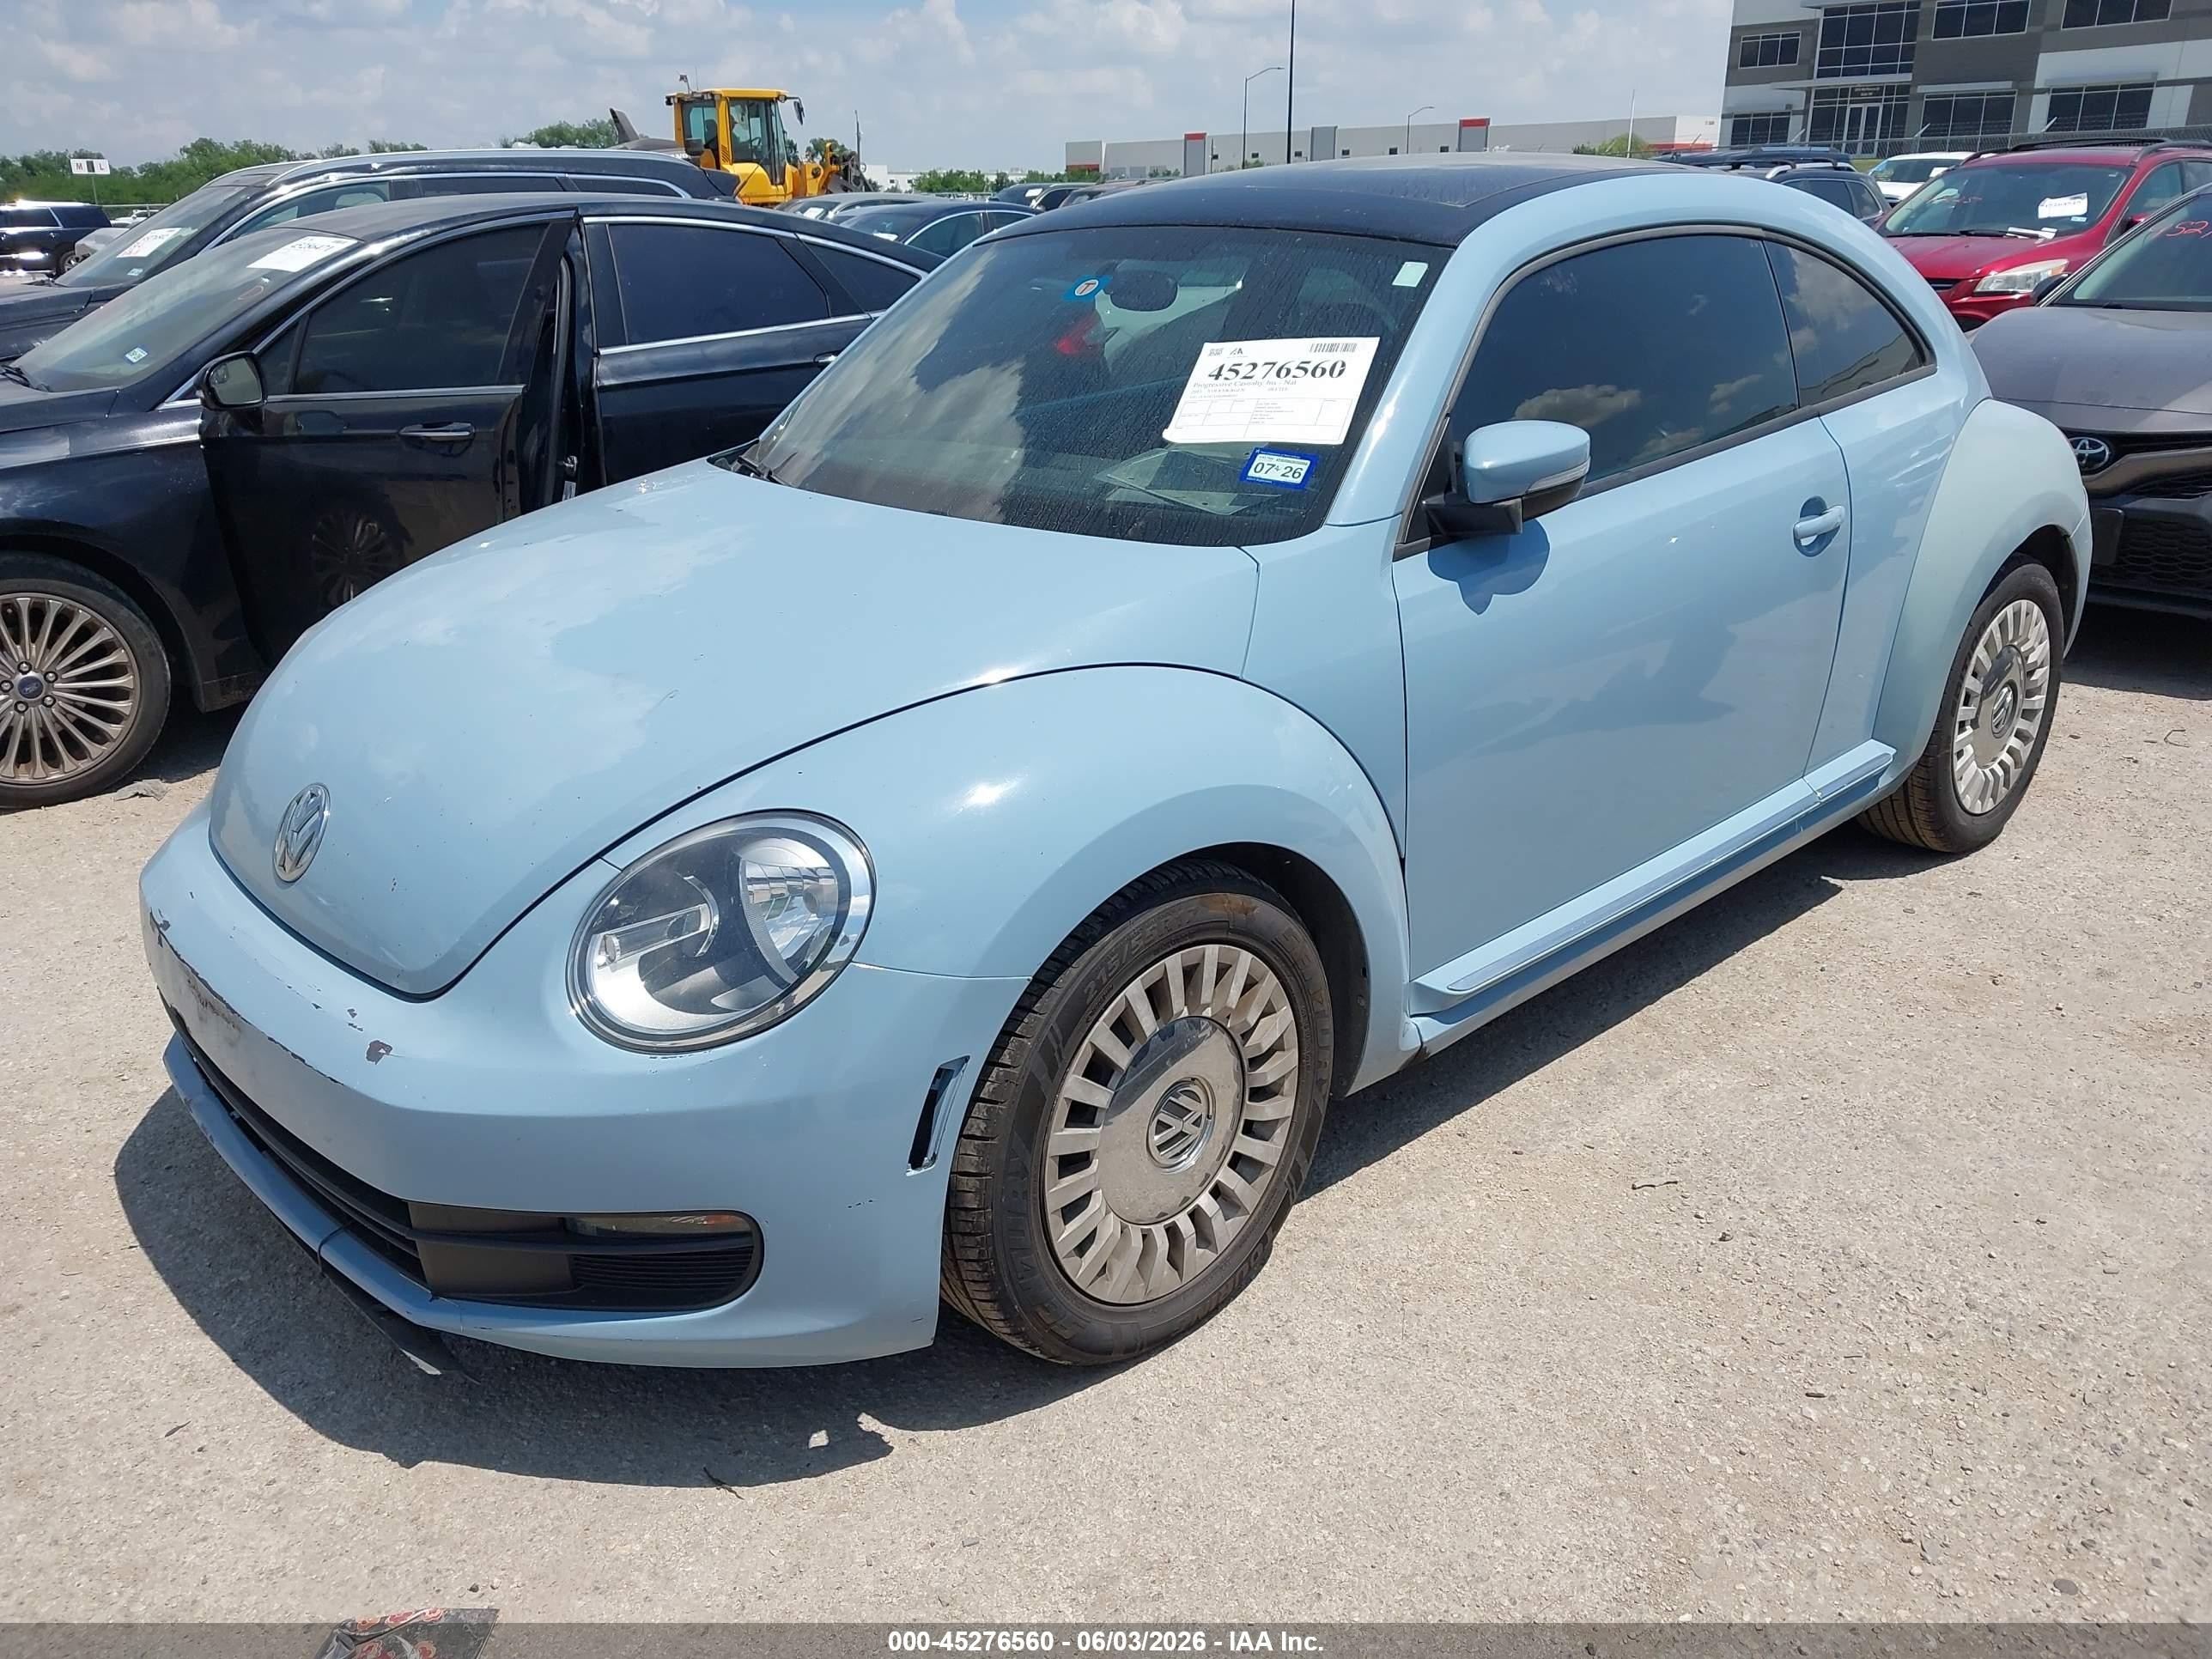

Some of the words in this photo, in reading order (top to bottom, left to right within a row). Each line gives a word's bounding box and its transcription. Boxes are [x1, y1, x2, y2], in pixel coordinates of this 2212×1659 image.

[1208, 360, 1346, 381] 45276560
[1254, 462, 1276, 475] 07
[1280, 465, 1304, 479] 26
